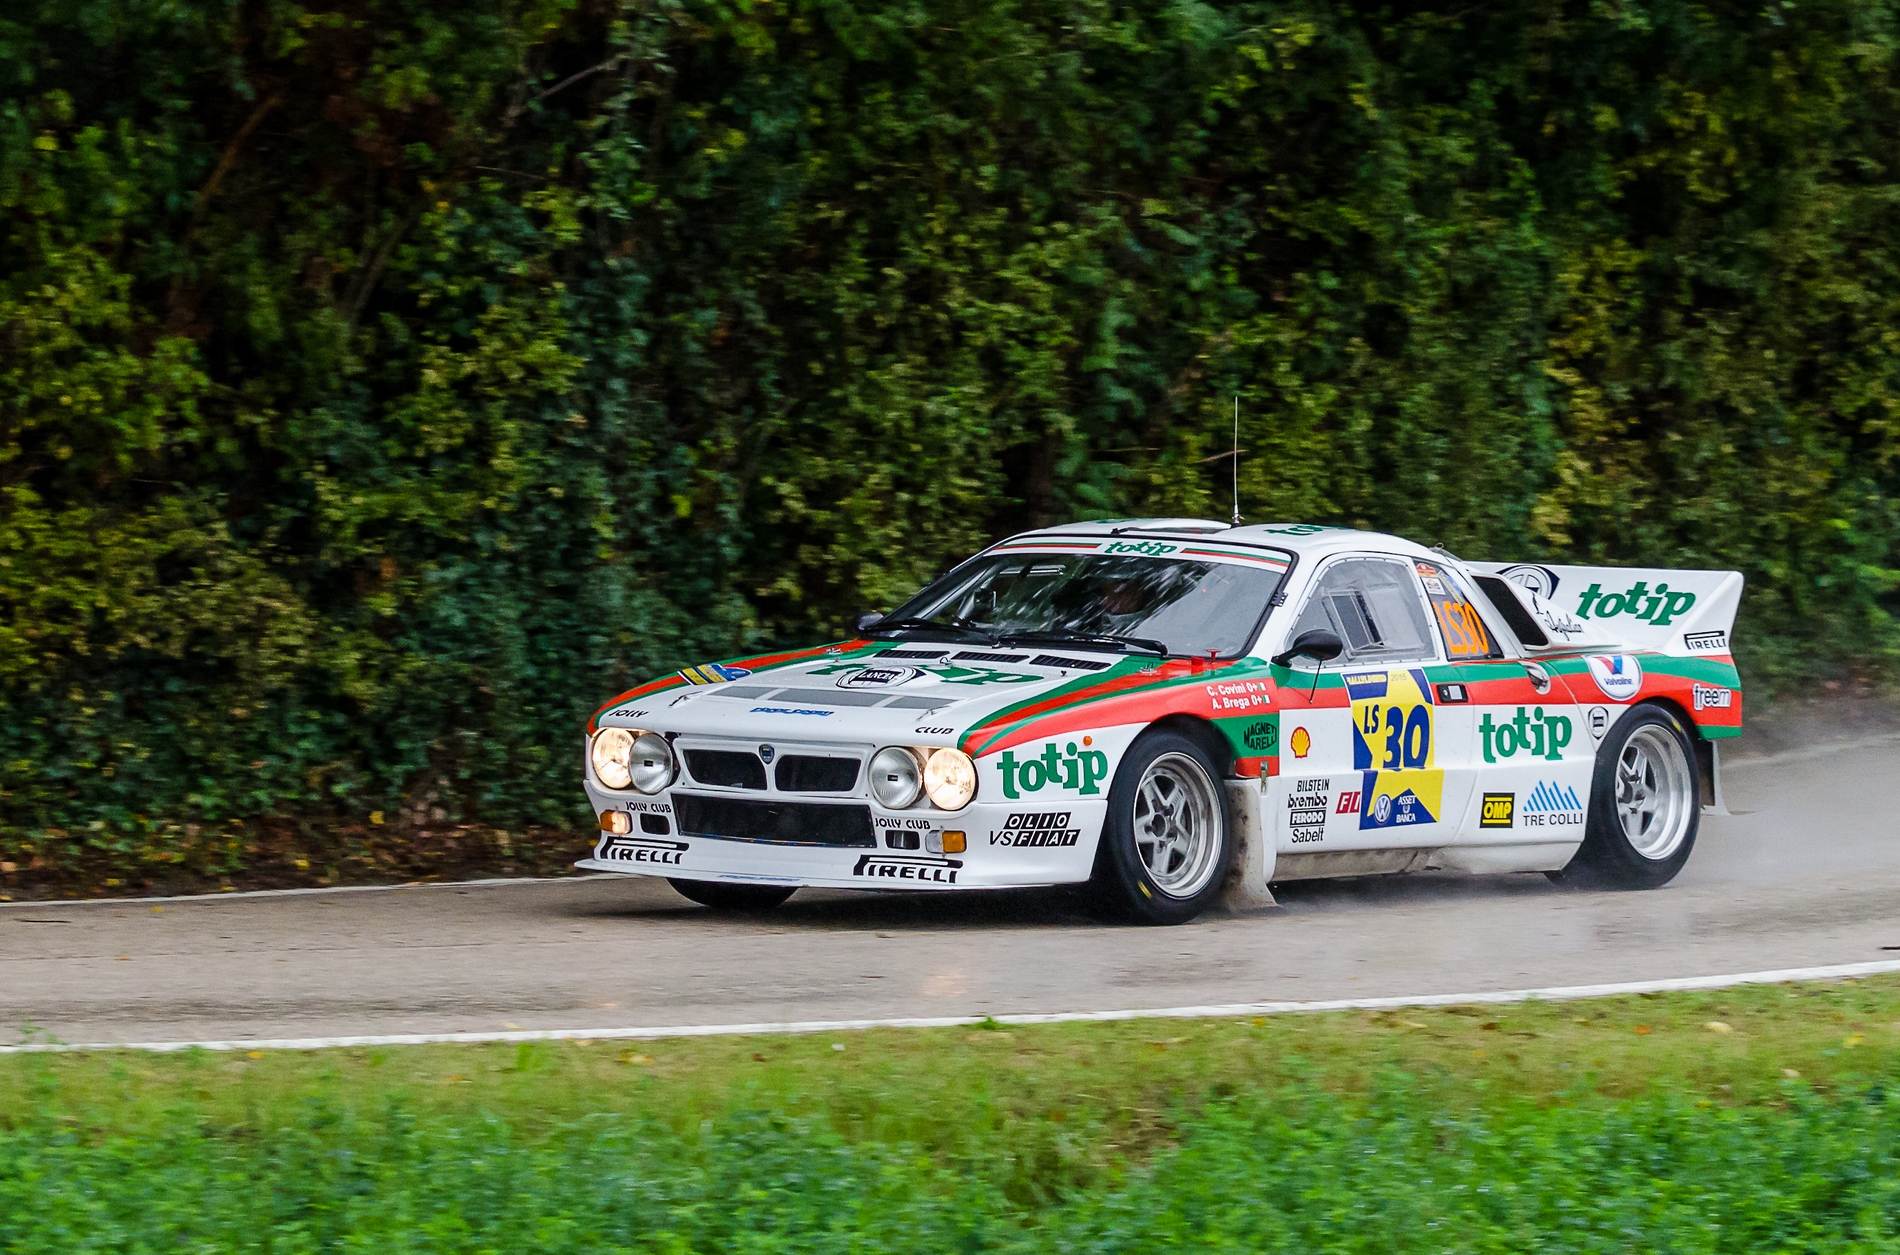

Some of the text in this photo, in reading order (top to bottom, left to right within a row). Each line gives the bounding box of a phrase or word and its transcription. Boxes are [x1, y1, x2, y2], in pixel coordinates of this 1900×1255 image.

[1104, 541, 1178, 556] totip
[1575, 581, 1697, 626] totip
[1684, 630, 1727, 650] PIRELLI
[1390, 673, 1407, 682] 2015
[1603, 677, 1633, 686] Valvoline
[1206, 685, 1219, 697] C.
[1218, 683, 1247, 696] Covini
[1694, 684, 1731, 709] freem
[1212, 697, 1222, 710] A.
[1222, 697, 1250, 710] Brega
[915, 726, 955, 735] CLUB
[1364, 704, 1430, 771] LS 30
[1479, 706, 1572, 763] totip
[996, 742, 1108, 799] totip
[1297, 779, 1330, 792] BILSTEIN
[625, 801, 672, 814] JOLLY CLUB
[1288, 792, 1328, 808] brembo
[1398, 795, 1417, 806] ASSET
[1483, 801, 1513, 819] OMP
[875, 818, 931, 830] JOLLY CLUB
[1003, 812, 1072, 830] OLIO
[1291, 811, 1325, 825] FERODO
[1396, 813, 1416, 824] BANCA
[1523, 813, 1583, 827] TRE COLLI
[1012, 829, 1081, 847] FIAT
[1292, 827, 1324, 843] Sabelt
[600, 836, 690, 864] PIRELLI
[853, 854, 964, 884] PIRELLI
